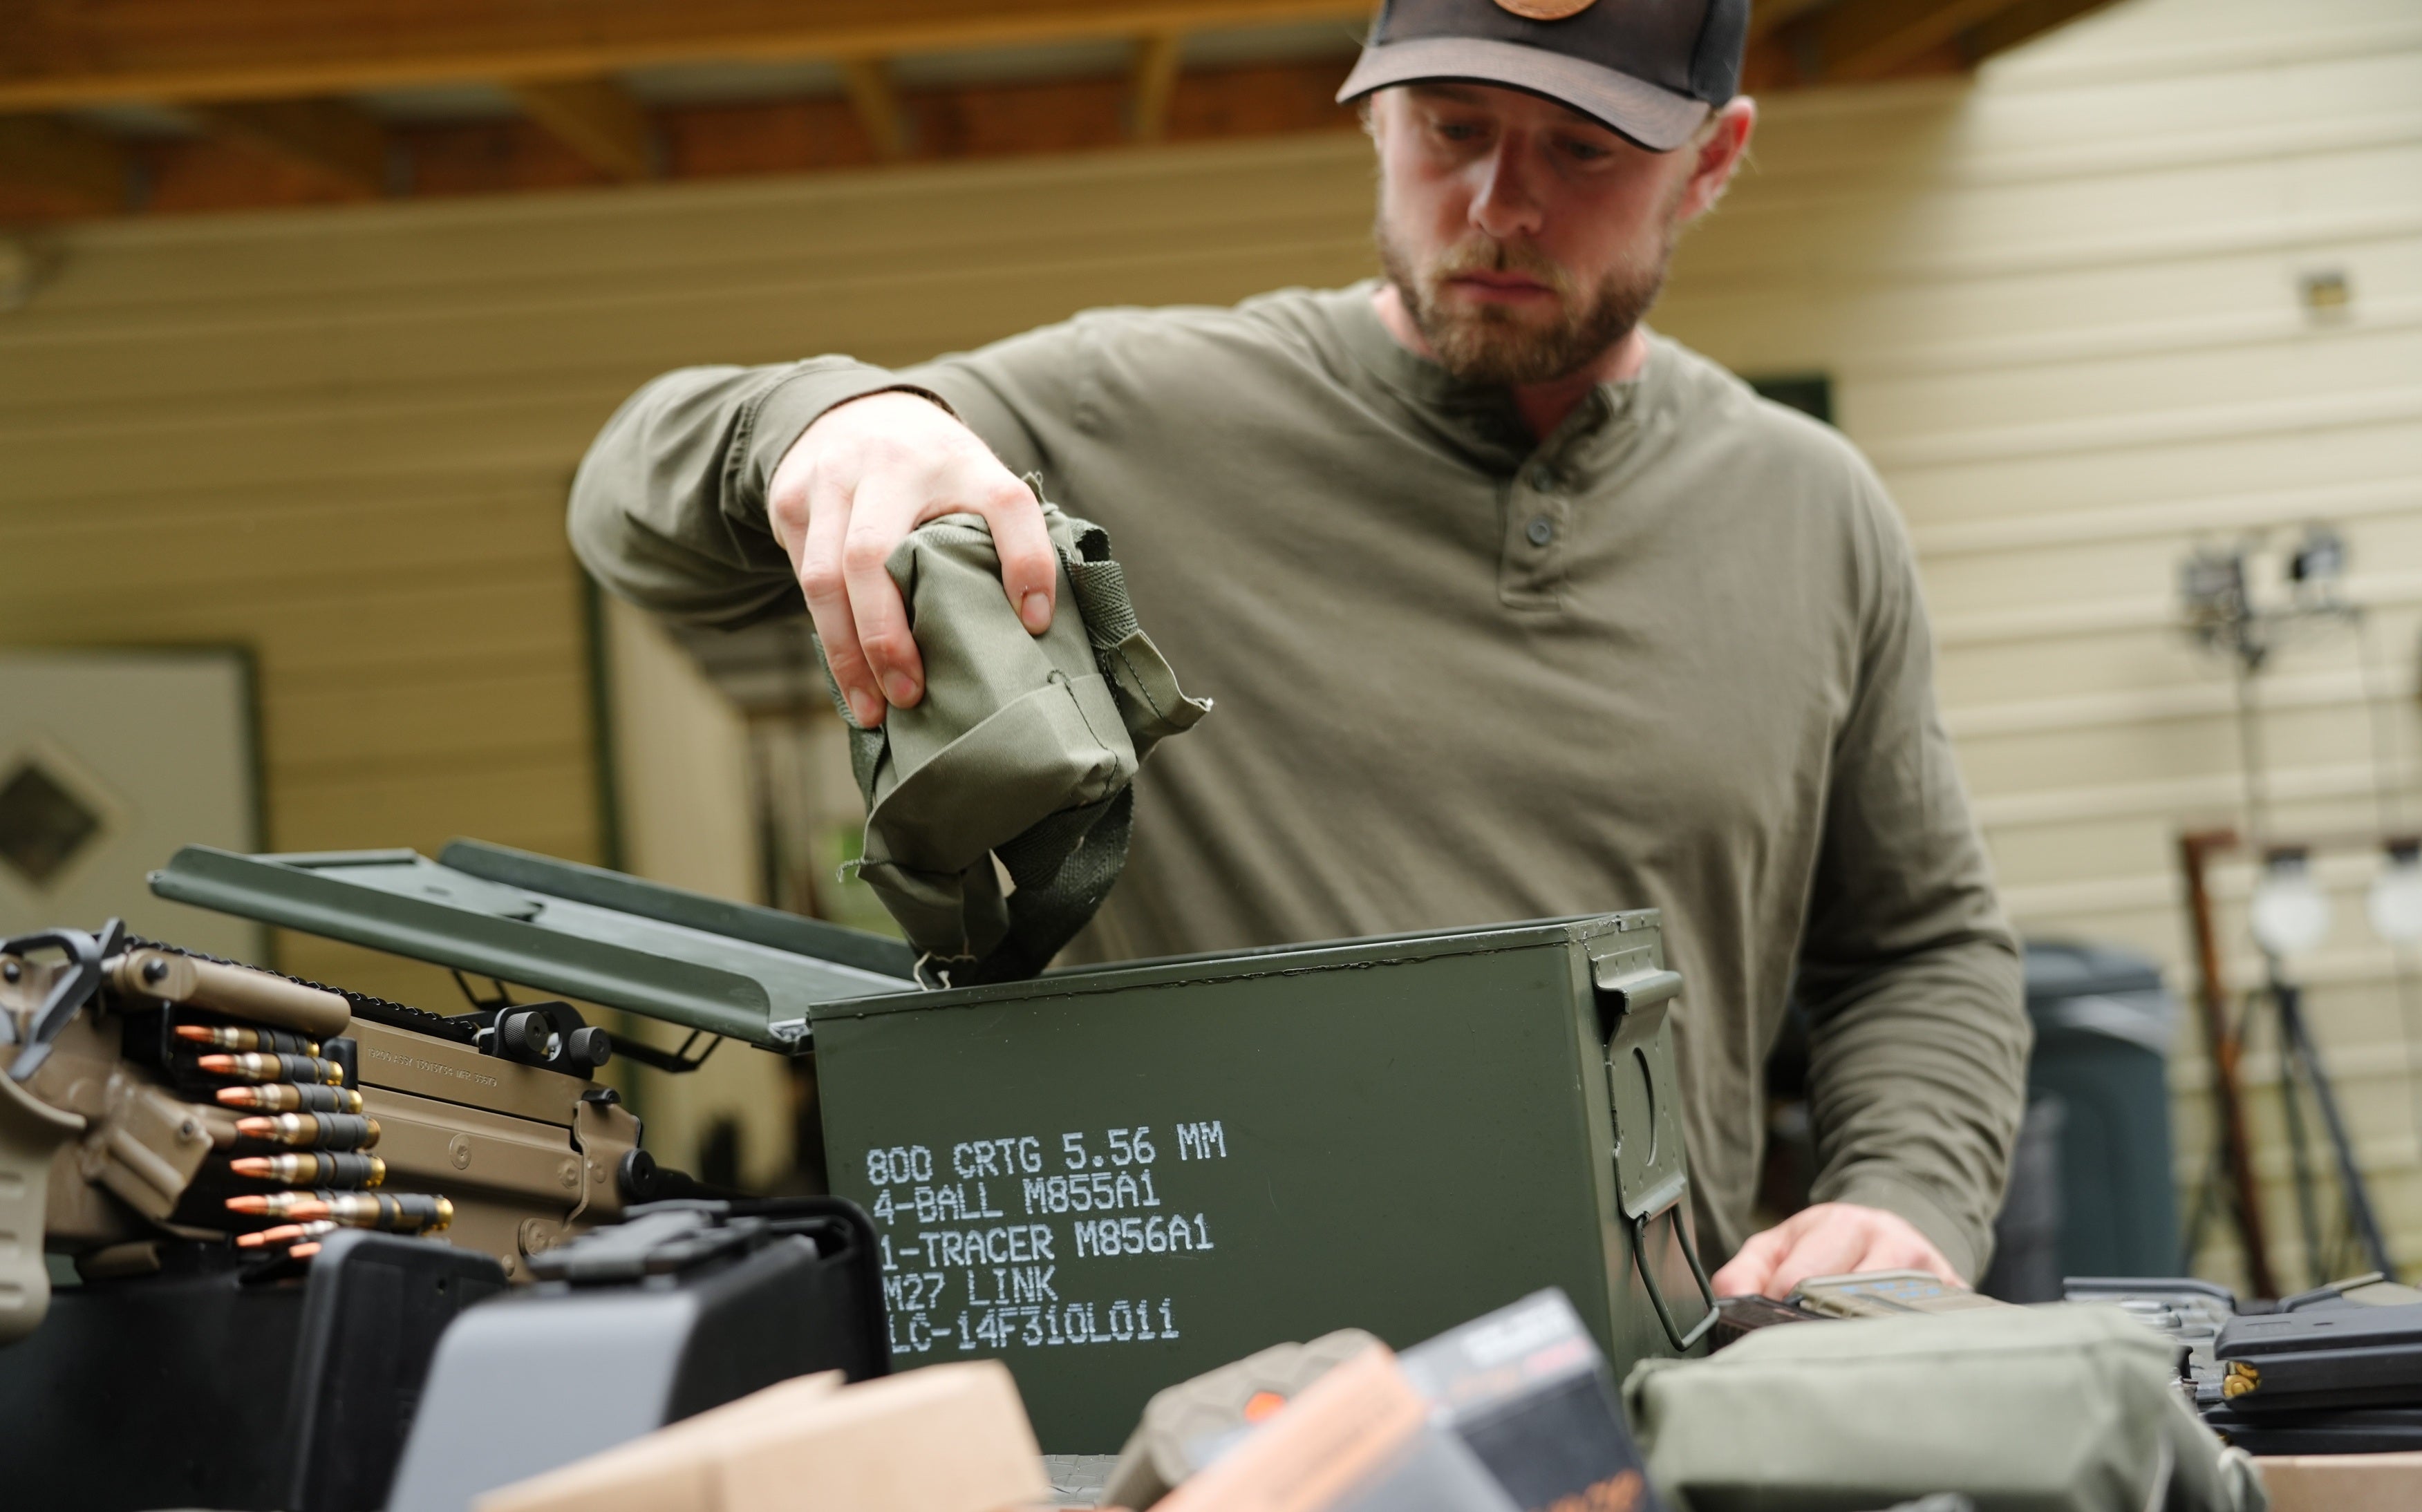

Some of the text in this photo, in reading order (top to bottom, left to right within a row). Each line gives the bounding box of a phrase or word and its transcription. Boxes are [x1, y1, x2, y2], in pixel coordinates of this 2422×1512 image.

[393, 1055, 413, 1066] ASSY
[867, 1120, 1226, 1185] 800 CRTG 5.56 MM
[873, 1169, 1161, 1225] 4-BALL M855A1
[881, 1213, 1214, 1270] 1-TRACER M856A1
[882, 1265, 1058, 1312] M27 LINK
[888, 1298, 1179, 1354] LC-14F310L011
